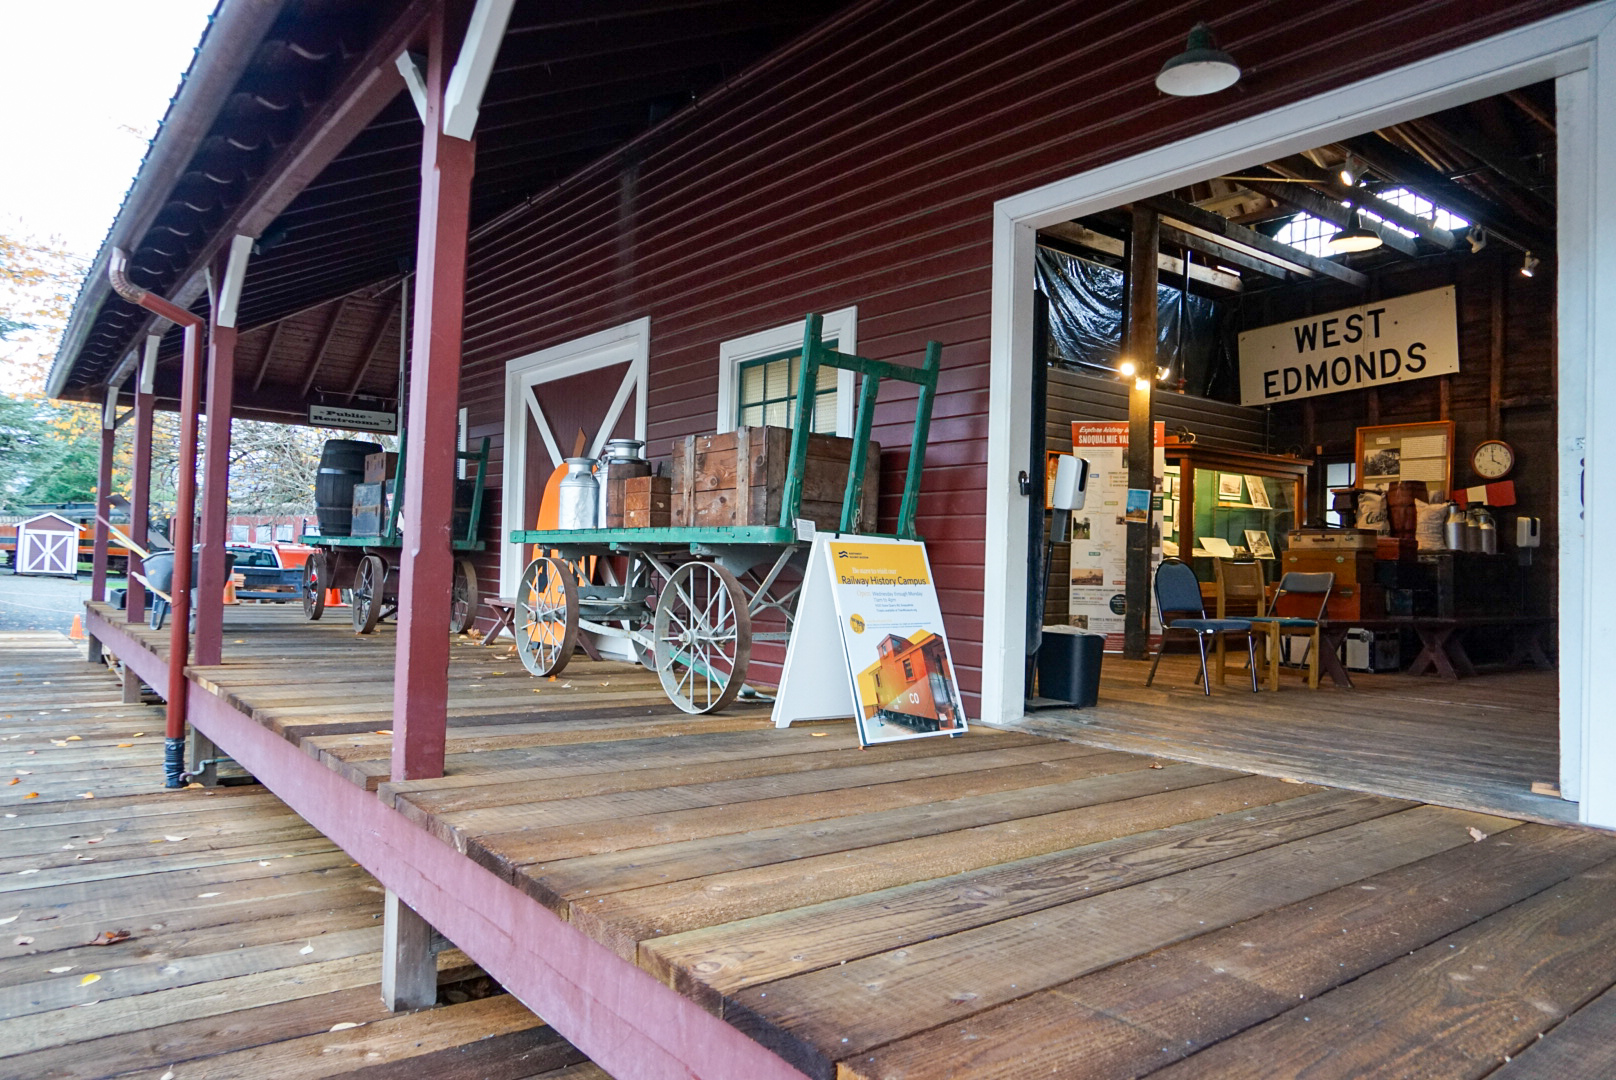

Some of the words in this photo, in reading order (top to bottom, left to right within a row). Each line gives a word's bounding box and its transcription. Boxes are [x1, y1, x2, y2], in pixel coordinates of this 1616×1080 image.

[1294, 307, 1386, 353] WEST
[1263, 342, 1427, 399] EDMONDS
[326, 410, 367, 419] Public
[313, 415, 380, 426] Restrooms
[1079, 426, 1102, 434] Explore
[1103, 426, 1123, 434] history
[1078, 434, 1118, 445] SNOQUALMIE
[841, 575, 869, 587] Railway
[870, 576, 896, 587] History
[897, 576, 926, 587] Campus
